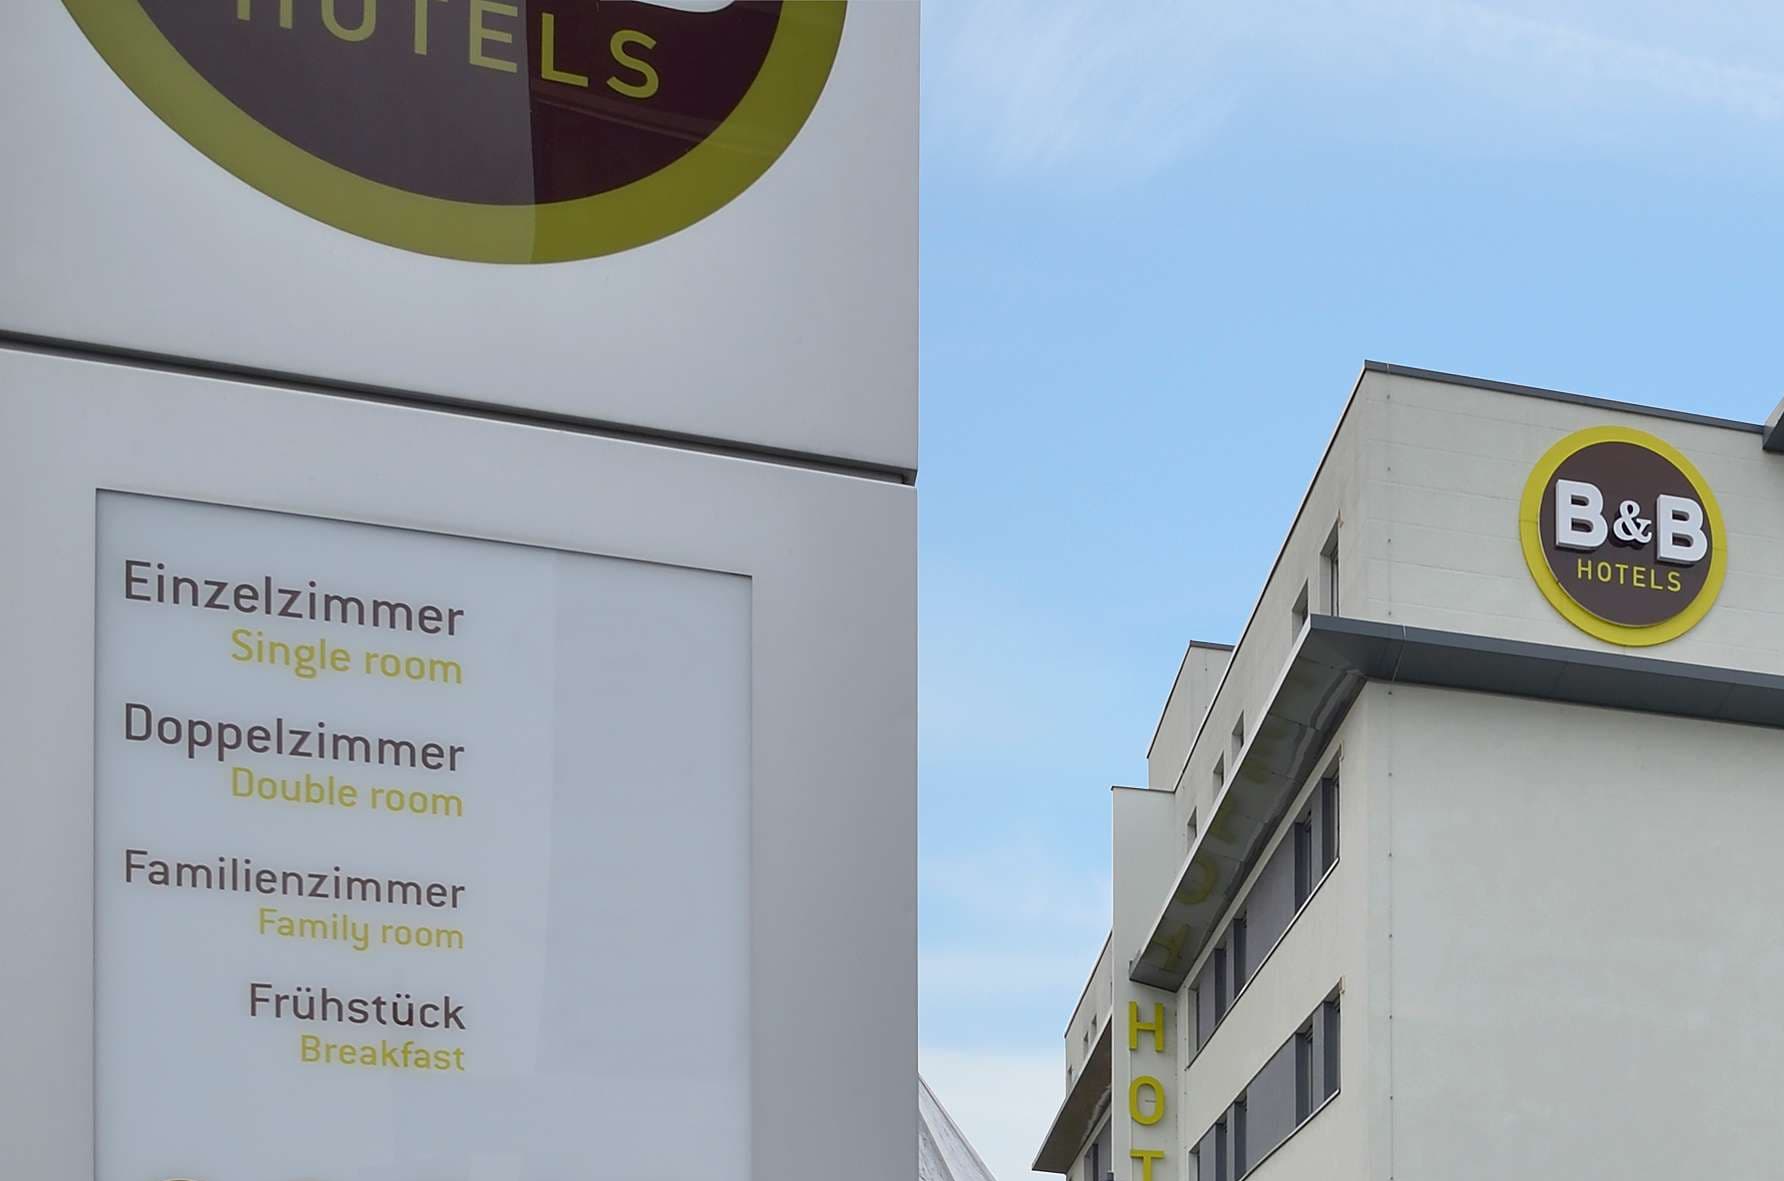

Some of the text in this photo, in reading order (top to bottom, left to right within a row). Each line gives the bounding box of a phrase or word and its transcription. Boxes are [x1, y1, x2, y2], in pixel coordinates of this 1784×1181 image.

[1556, 479, 1708, 563] B&B
[124, 559, 465, 636] Einzelzimmer
[1577, 559, 1681, 592] HOTELS
[230, 628, 463, 684] Single room
[125, 703, 465, 771] Doppelzimmer
[231, 766, 463, 817] Double room
[125, 849, 466, 908] Familienzimmer
[259, 907, 464, 951] Family room
[250, 982, 466, 1030] Frühstück
[301, 1034, 465, 1071] Breakfast
